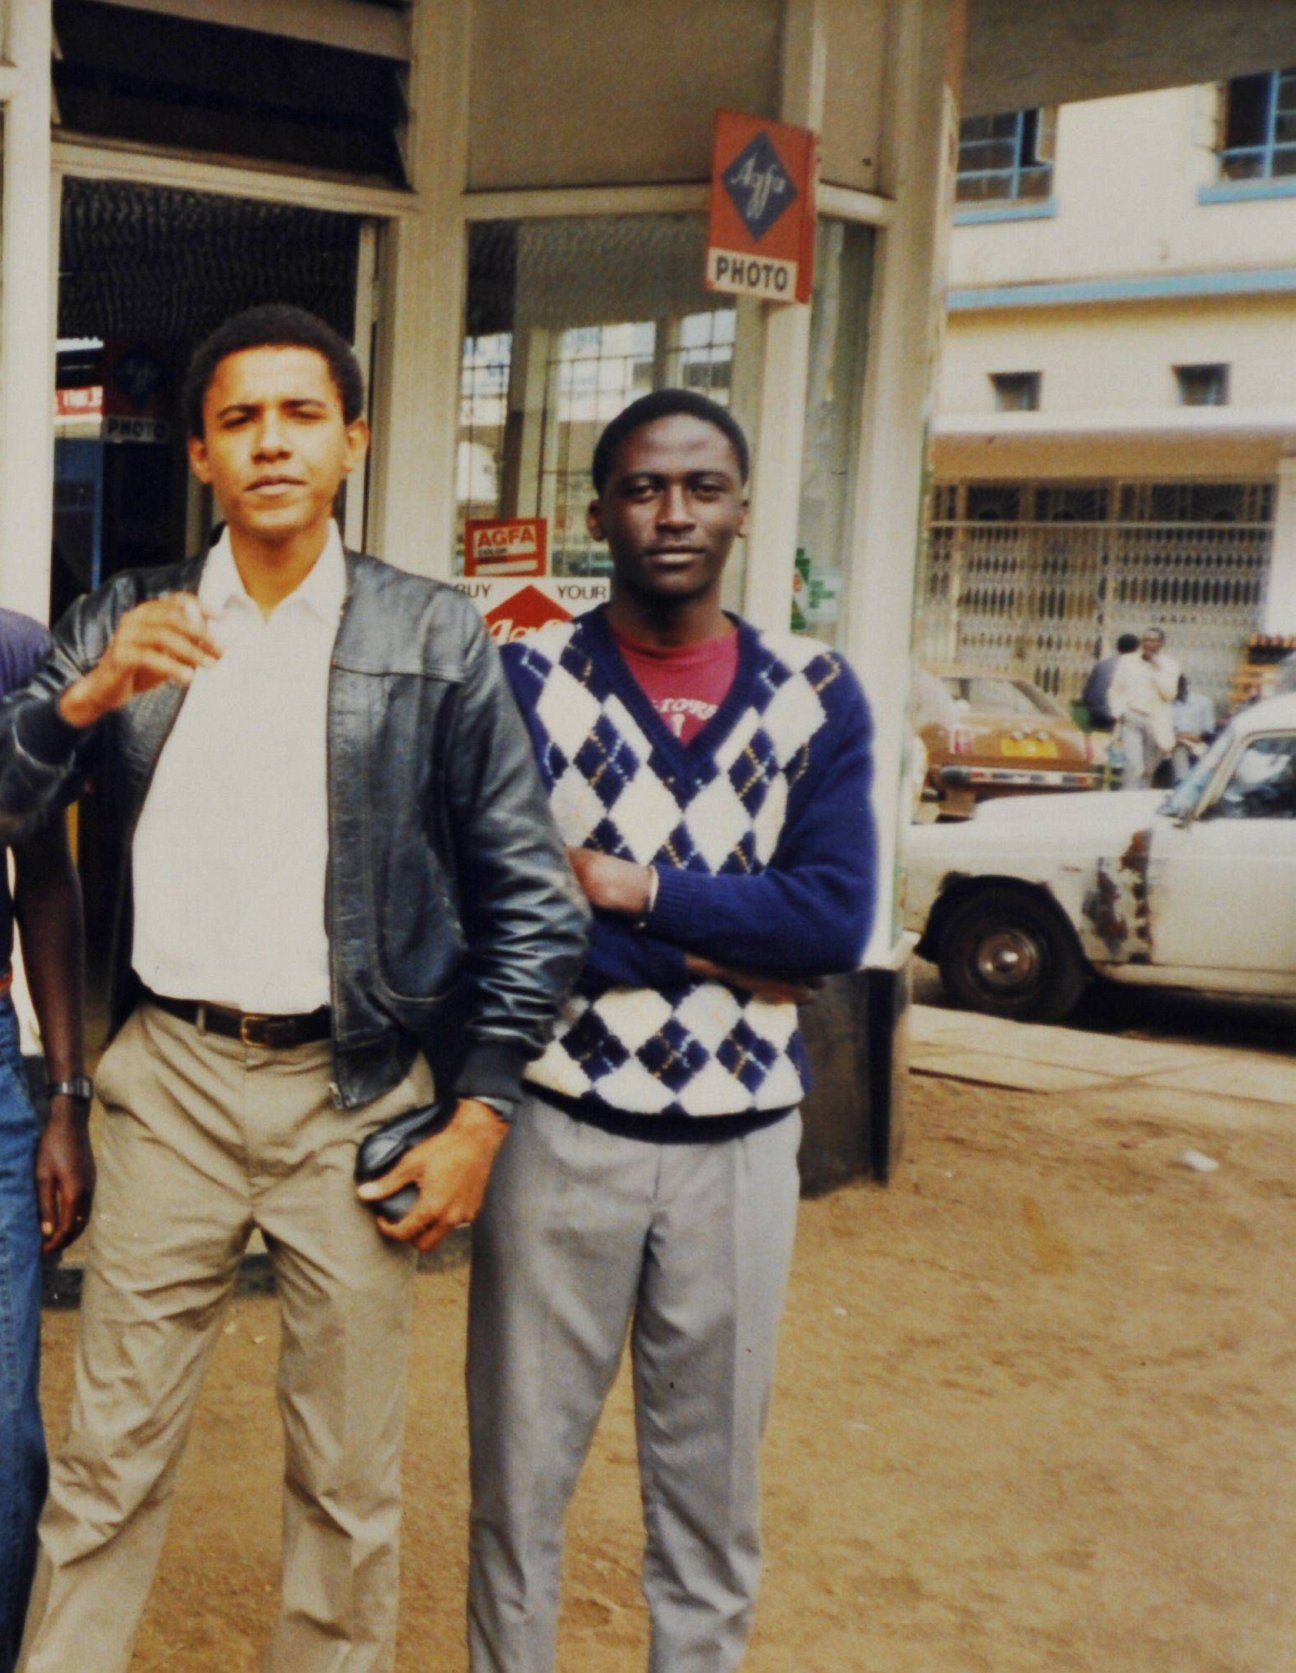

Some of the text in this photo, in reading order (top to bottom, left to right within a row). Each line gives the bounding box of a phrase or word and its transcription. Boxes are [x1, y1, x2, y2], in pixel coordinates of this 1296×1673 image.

[716, 256, 788, 291] PHOTO
[478, 527, 535, 547] AGFA
[558, 585, 607, 599] YOUR
